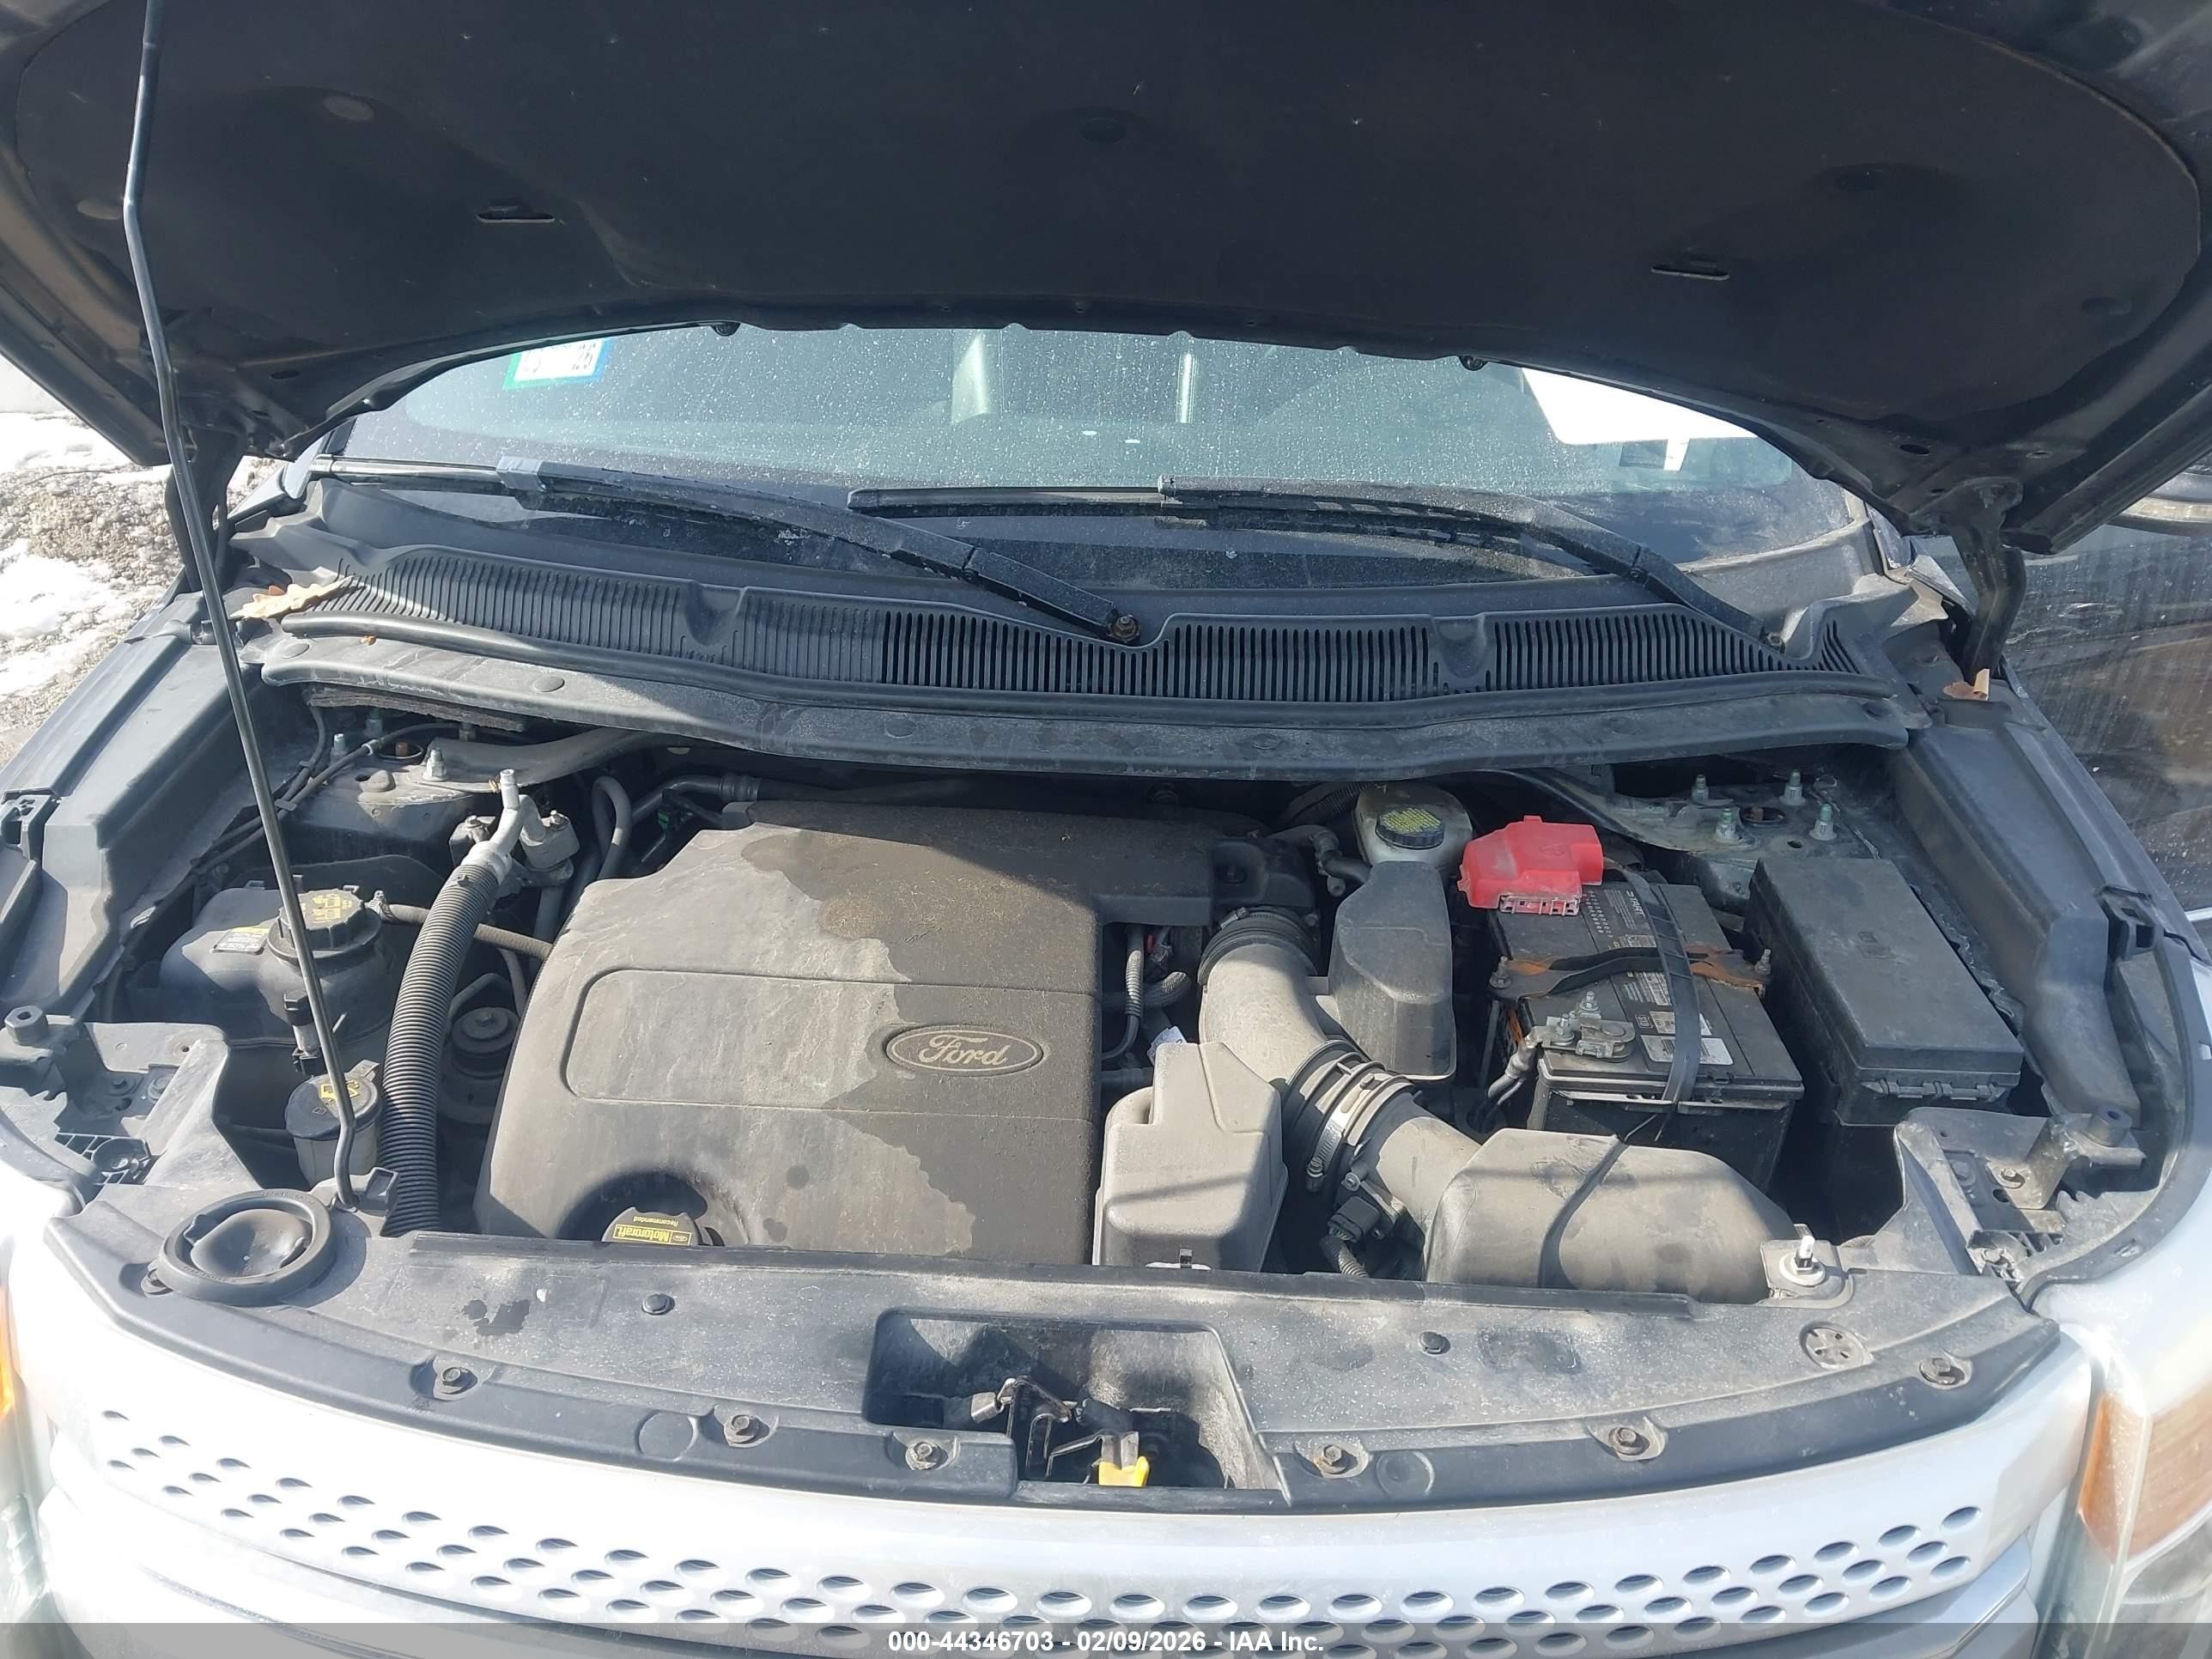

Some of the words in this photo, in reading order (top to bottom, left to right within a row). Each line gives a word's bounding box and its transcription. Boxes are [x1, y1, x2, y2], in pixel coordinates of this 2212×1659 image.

[919, 1034, 1010, 1065] Ford
[633, 1216, 679, 1227] Recommended
[617, 1227, 670, 1242] Motorcraft
